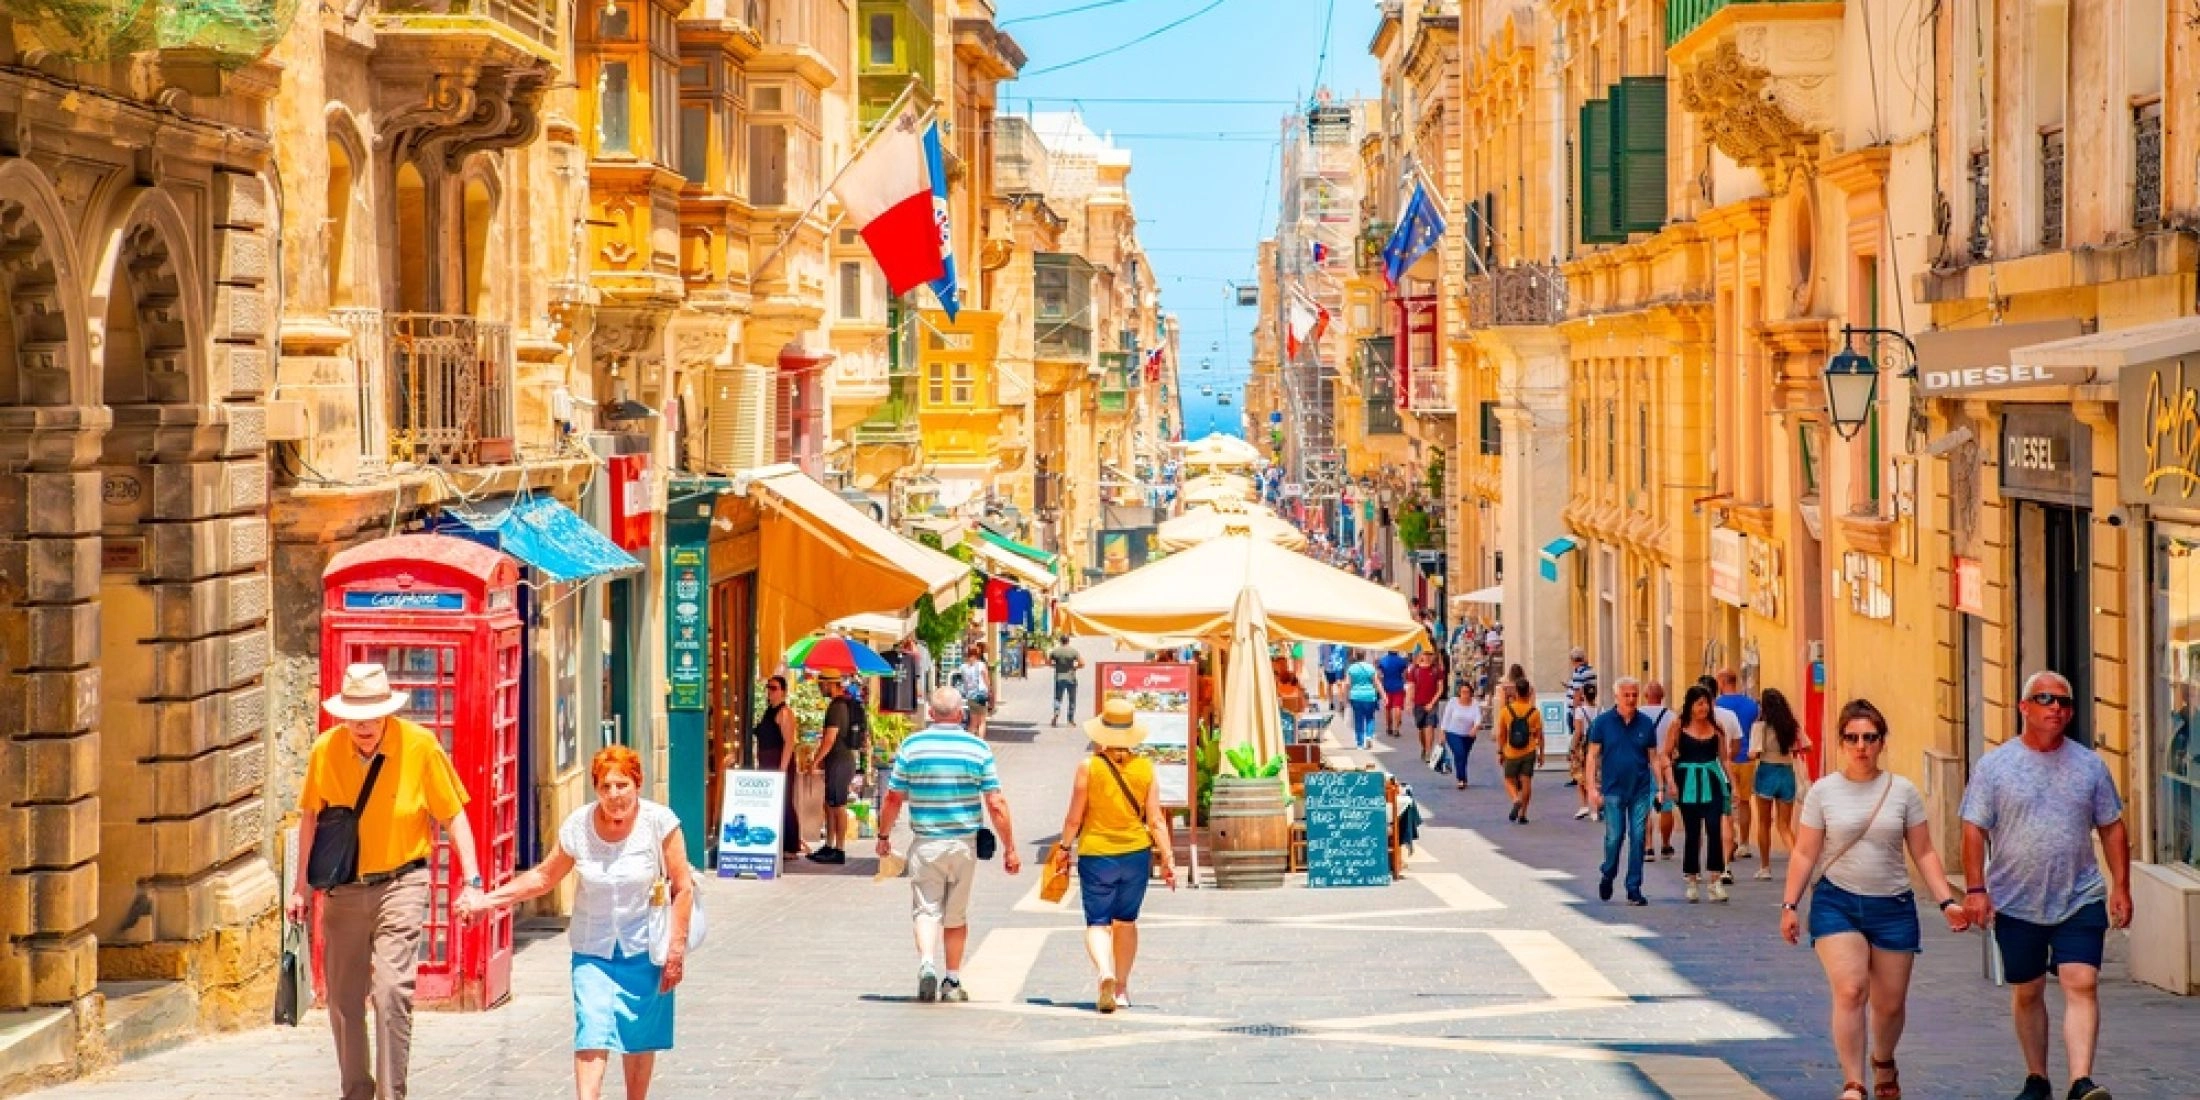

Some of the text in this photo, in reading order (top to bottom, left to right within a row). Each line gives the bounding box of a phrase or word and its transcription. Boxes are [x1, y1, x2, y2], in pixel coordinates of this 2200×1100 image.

[1925, 364, 2054, 389] DIESEL
[2008, 436, 2056, 471] DIESEL
[104, 480, 137, 498] 226
[371, 592, 439, 608] Cardphone
